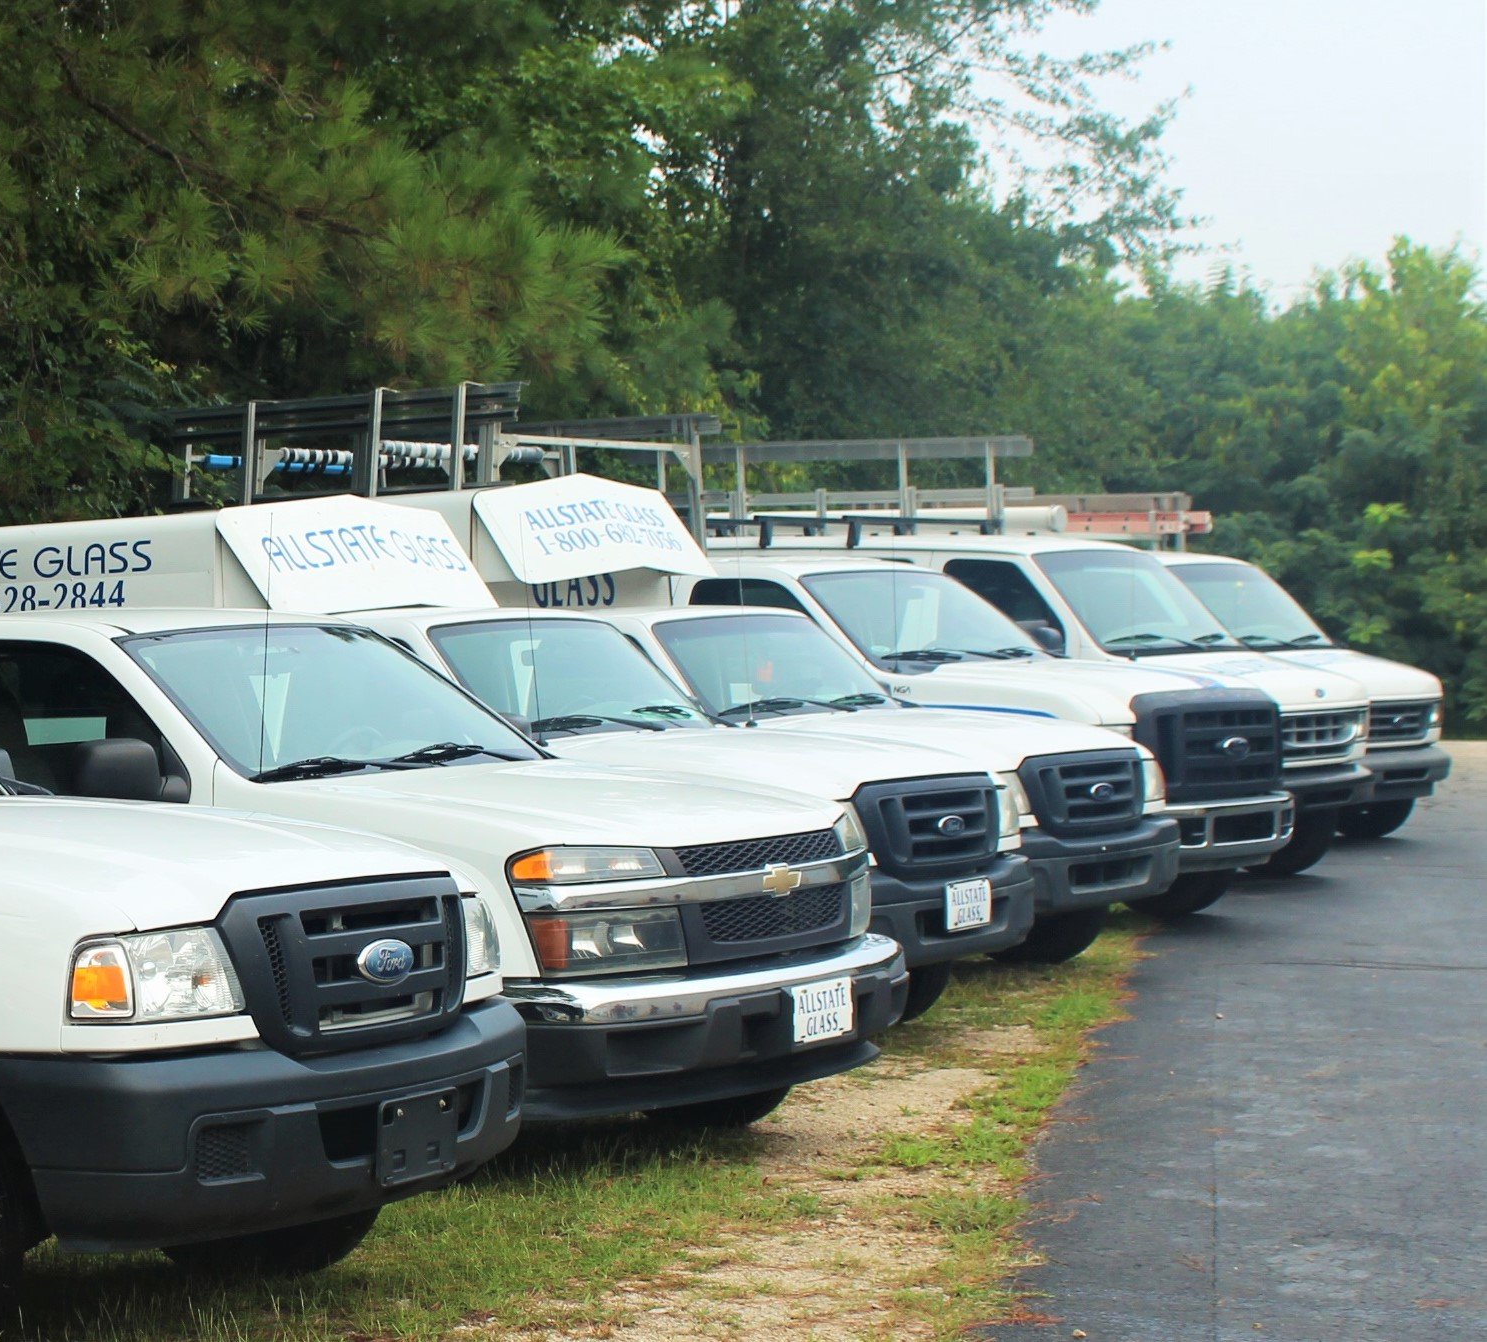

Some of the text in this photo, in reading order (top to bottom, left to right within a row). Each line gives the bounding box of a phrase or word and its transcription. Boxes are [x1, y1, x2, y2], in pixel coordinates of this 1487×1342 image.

[525, 500, 665, 531] ALLSTATE GLASS
[33, 540, 152, 579] GLASS
[261, 525, 467, 573] ALLSTATE GLASS
[952, 886, 987, 906] ALLSTATE
[377, 946, 406, 972] Ford
[798, 987, 846, 1015] ALLSTATE
[806, 1012, 839, 1036] GLASS
